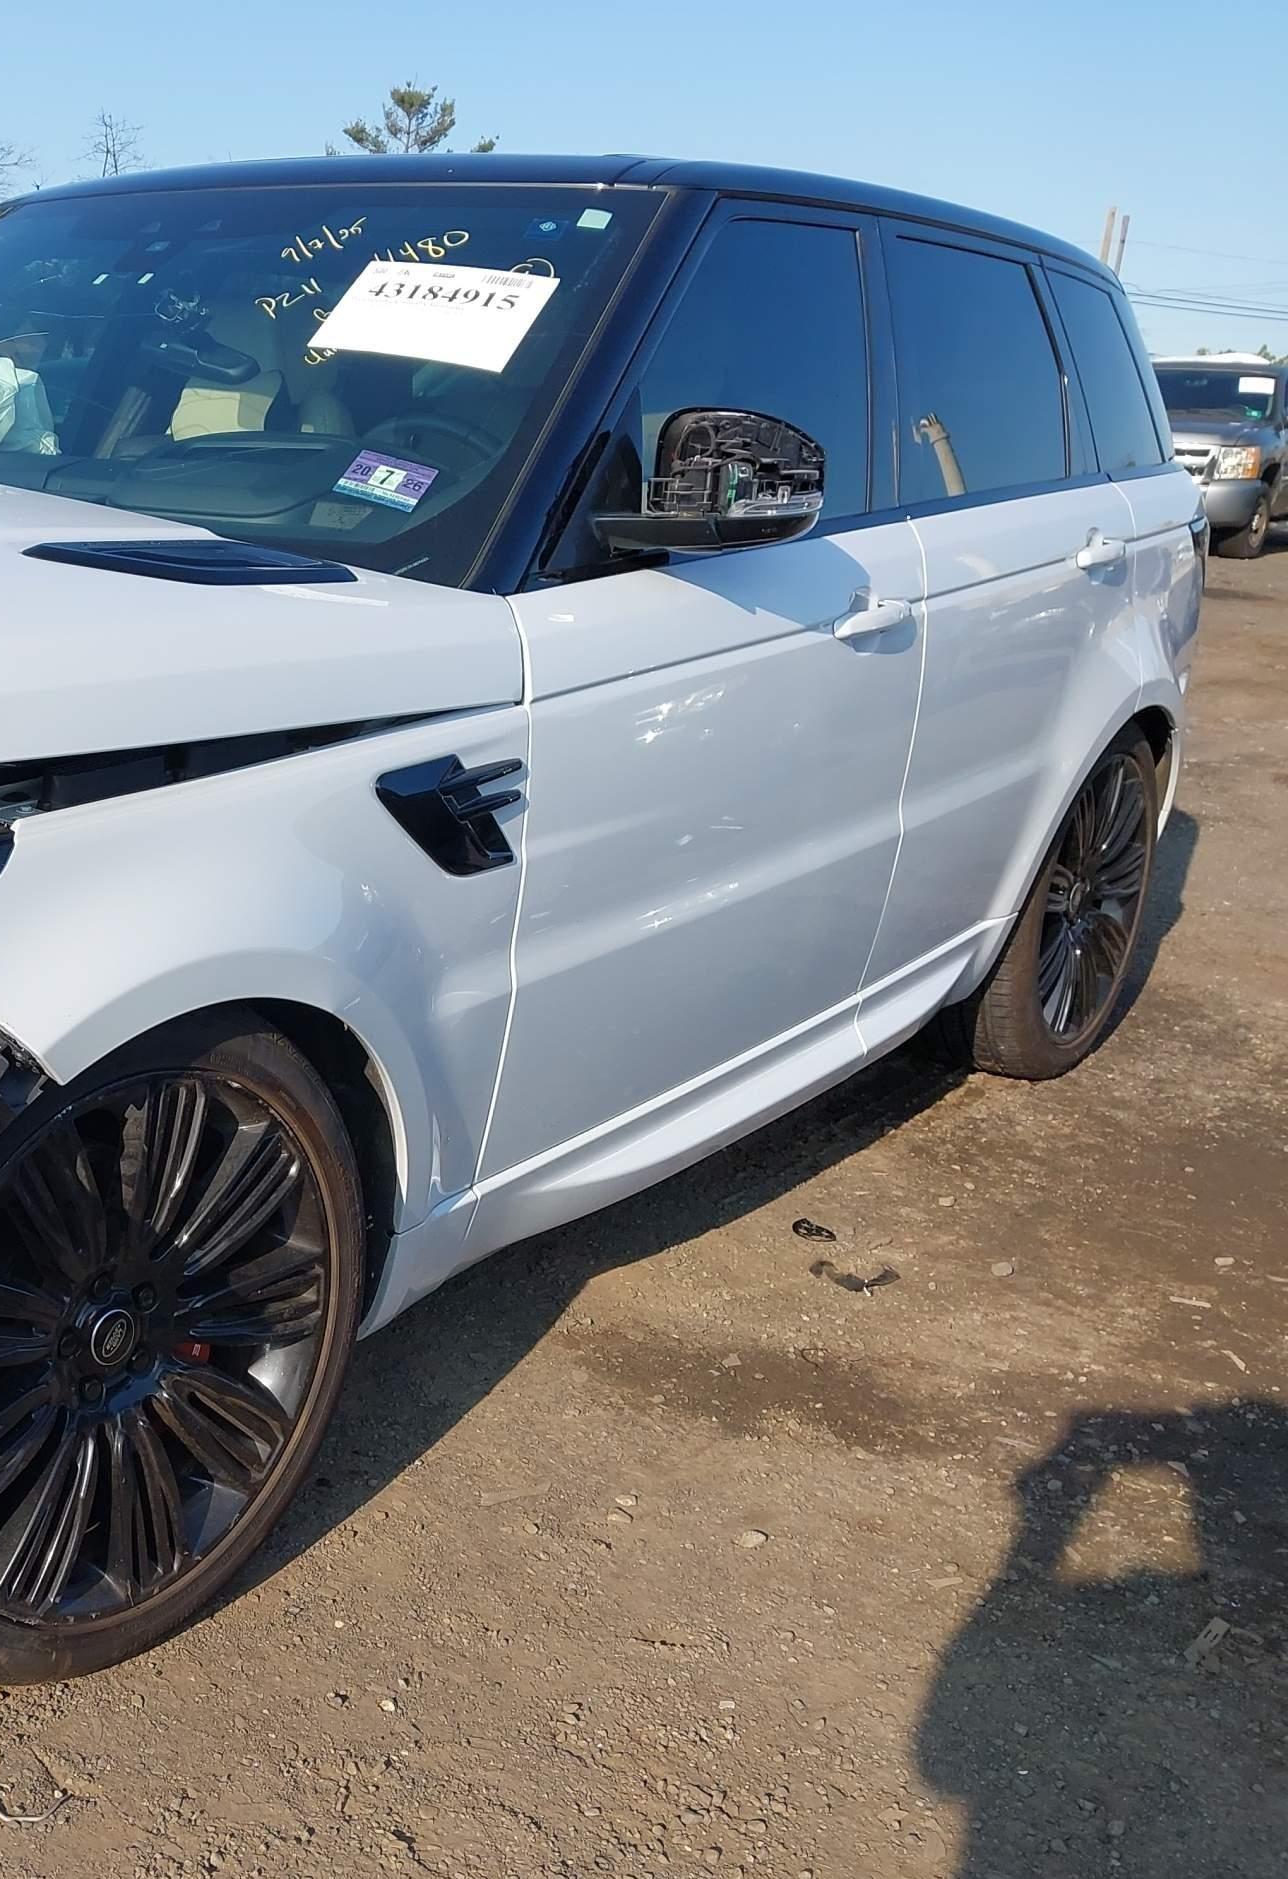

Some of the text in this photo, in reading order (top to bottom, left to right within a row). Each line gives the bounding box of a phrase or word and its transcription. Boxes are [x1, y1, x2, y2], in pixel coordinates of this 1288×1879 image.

[368, 281, 520, 311] 43184915
[352, 463, 371, 476] 20
[379, 469, 394, 485] 7
[403, 478, 424, 491] 26
